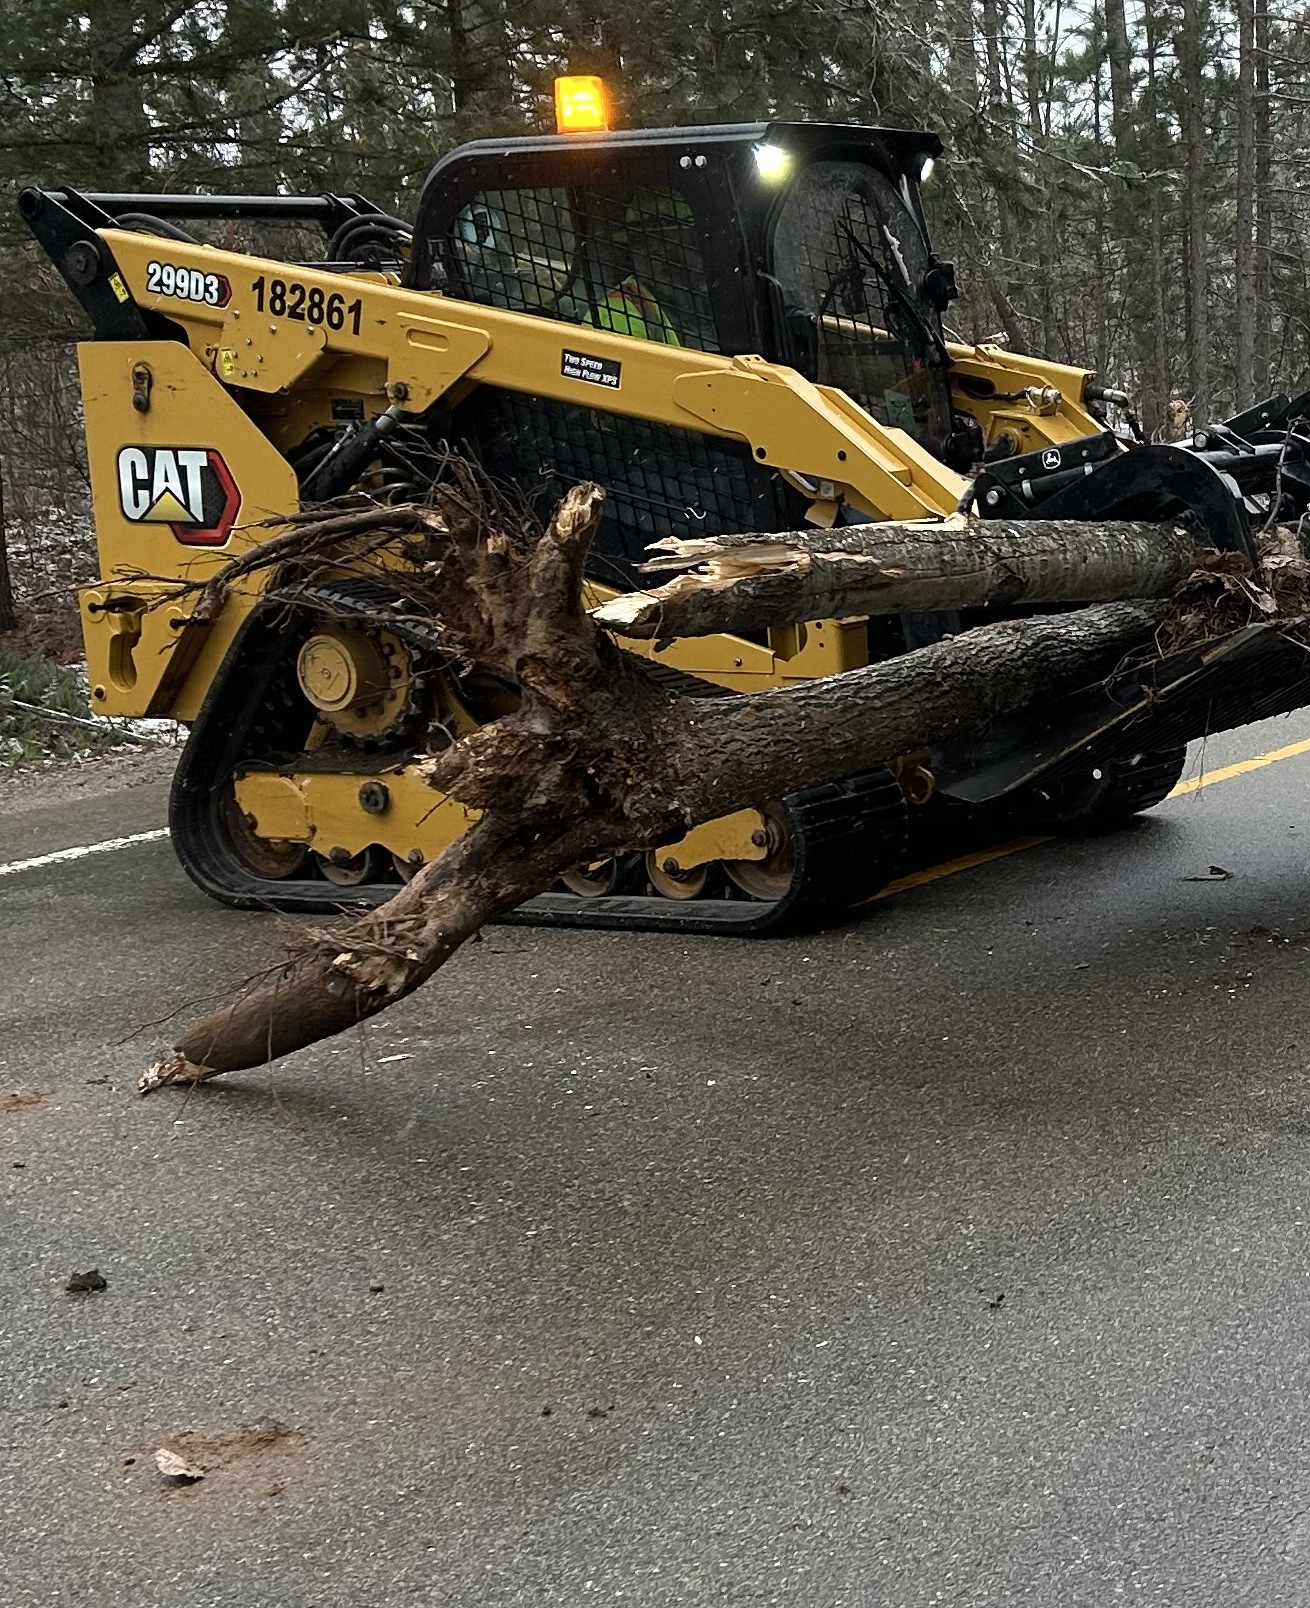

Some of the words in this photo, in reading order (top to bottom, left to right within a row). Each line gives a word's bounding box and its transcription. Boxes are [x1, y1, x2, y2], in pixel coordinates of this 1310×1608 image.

[148, 262, 219, 304] 299D3
[252, 275, 363, 336] 182861
[119, 448, 208, 522] CAT
